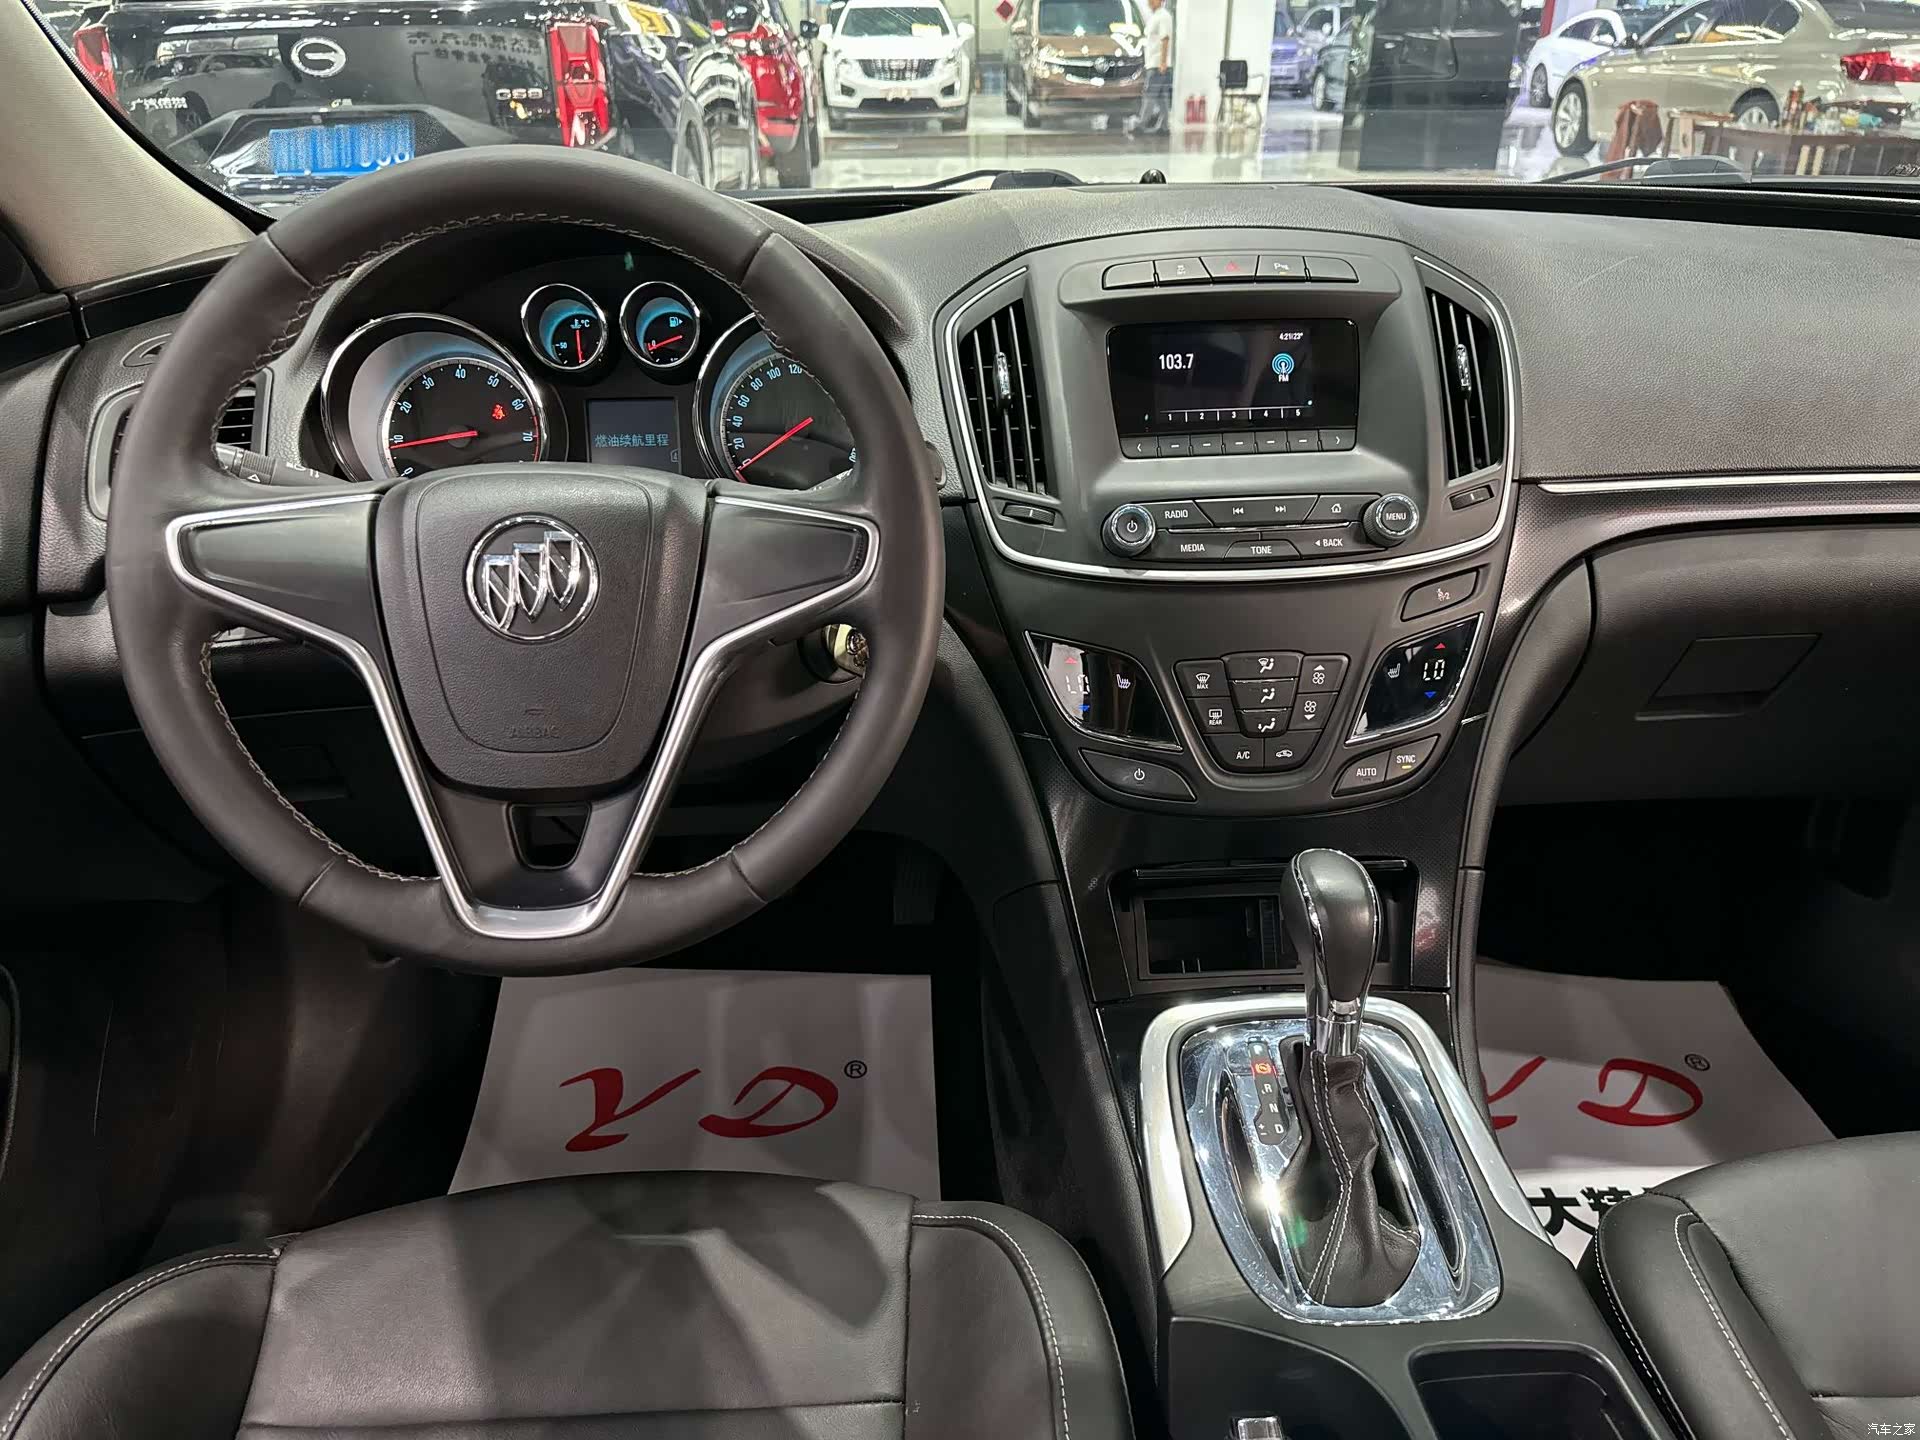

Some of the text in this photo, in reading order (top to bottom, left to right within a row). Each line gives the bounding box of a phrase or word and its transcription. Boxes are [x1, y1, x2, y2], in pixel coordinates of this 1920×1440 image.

[1159, 353, 1194, 370] 103.7
[455, 368, 467, 379] 40
[766, 367, 781, 380] 100
[421, 377, 435, 390] 30
[487, 375, 500, 388] 50
[750, 378, 764, 391] 80
[511, 398, 524, 411] 60
[737, 394, 750, 408] 60
[400, 401, 413, 414] 20
[732, 415, 744, 428] 40
[393, 434, 404, 444] 10
[522, 432, 533, 442] 70
[594, 434, 669, 447] 燃油续航里程
[733, 437, 745, 450] 20
[1164, 510, 1189, 519] RADIO
[1386, 512, 1407, 521] MENU
[1180, 544, 1205, 553] MEDIA
[1322, 538, 1343, 548] BACK
[1251, 546, 1272, 555] TONE
[1235, 750, 1251, 760] A/C
[1396, 754, 1416, 764] SYNC
[1356, 767, 1377, 777] AUTO
[1263, 1083, 1273, 1093] R
[1268, 1103, 1279, 1113] N
[1274, 1123, 1284, 1134] D
